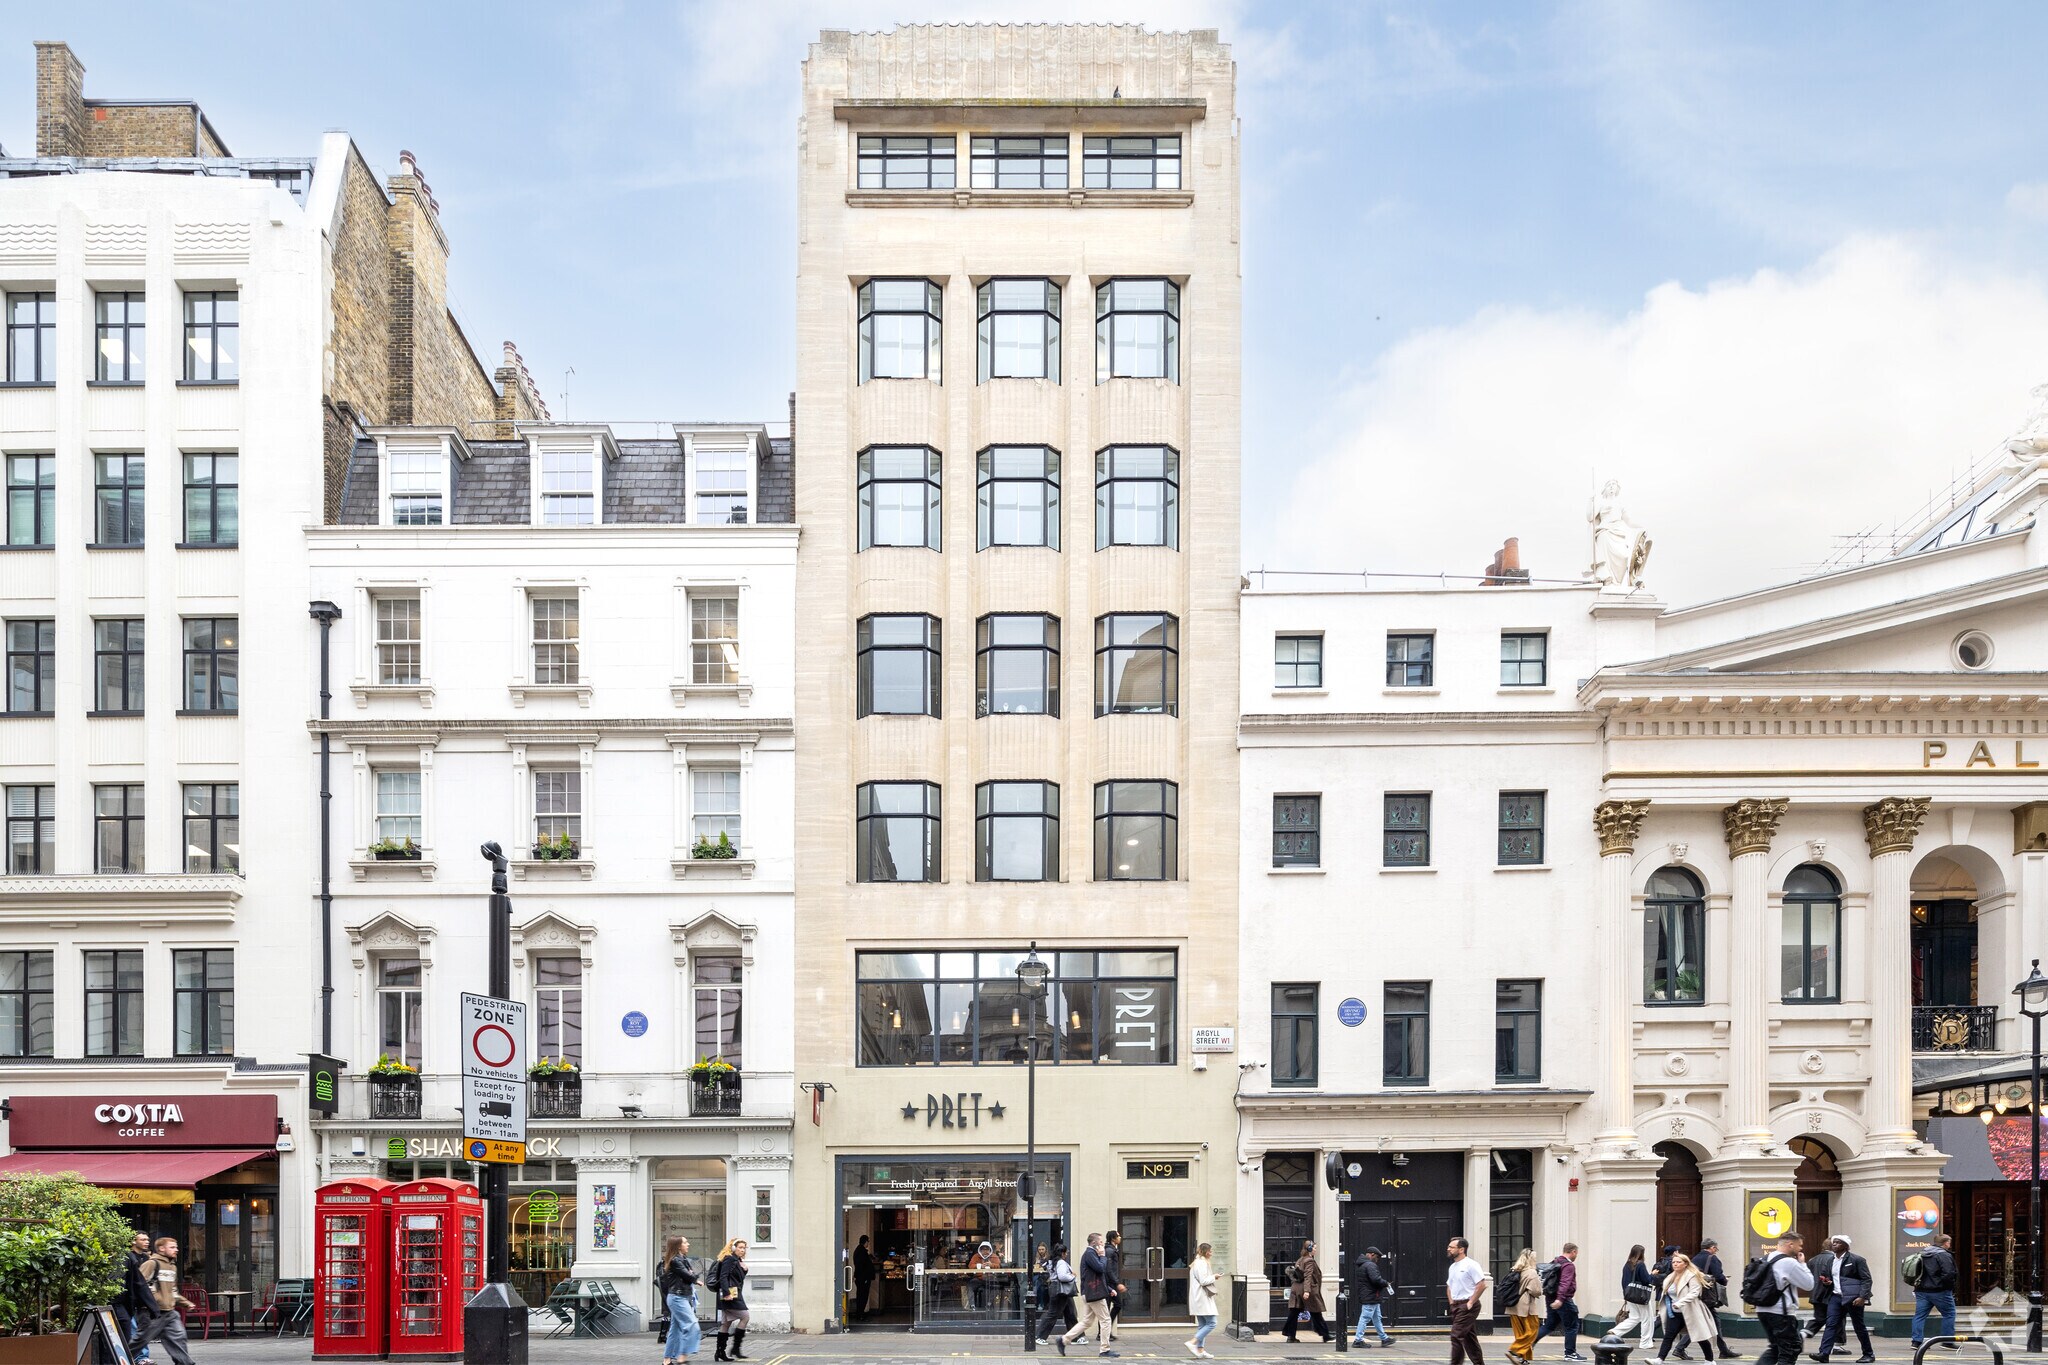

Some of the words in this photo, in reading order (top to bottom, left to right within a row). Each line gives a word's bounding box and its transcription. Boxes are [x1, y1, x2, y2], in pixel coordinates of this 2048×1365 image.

[1923, 740, 2040, 768] PAL
[465, 996, 522, 1013] PEDESTRIAN
[474, 1008, 514, 1025] ZONE
[1115, 988, 1155, 1051] PRET
[1945, 1025, 1958, 1041] P
[471, 1066, 483, 1075] No
[486, 1069, 518, 1080] vehicles
[474, 1080, 502, 1090] Except
[504, 1084, 516, 1092] for
[474, 1089, 504, 1100] loading
[506, 1093, 516, 1101] by
[95, 1104, 184, 1125] COSTA
[927, 1092, 982, 1128] PRET
[479, 1119, 512, 1128] between
[118, 1128, 165, 1137] COFFEE
[472, 1127, 492, 1135] 11pm
[500, 1130, 519, 1138] 11am
[409, 1137, 463, 1156] SHAK
[505, 1146, 519, 1154] any
[891, 1180, 919, 1190] Freshly
[968, 1179, 993, 1190] Argyll
[994, 1180, 1017, 1188] Street
[128, 1190, 139, 1201] Go
